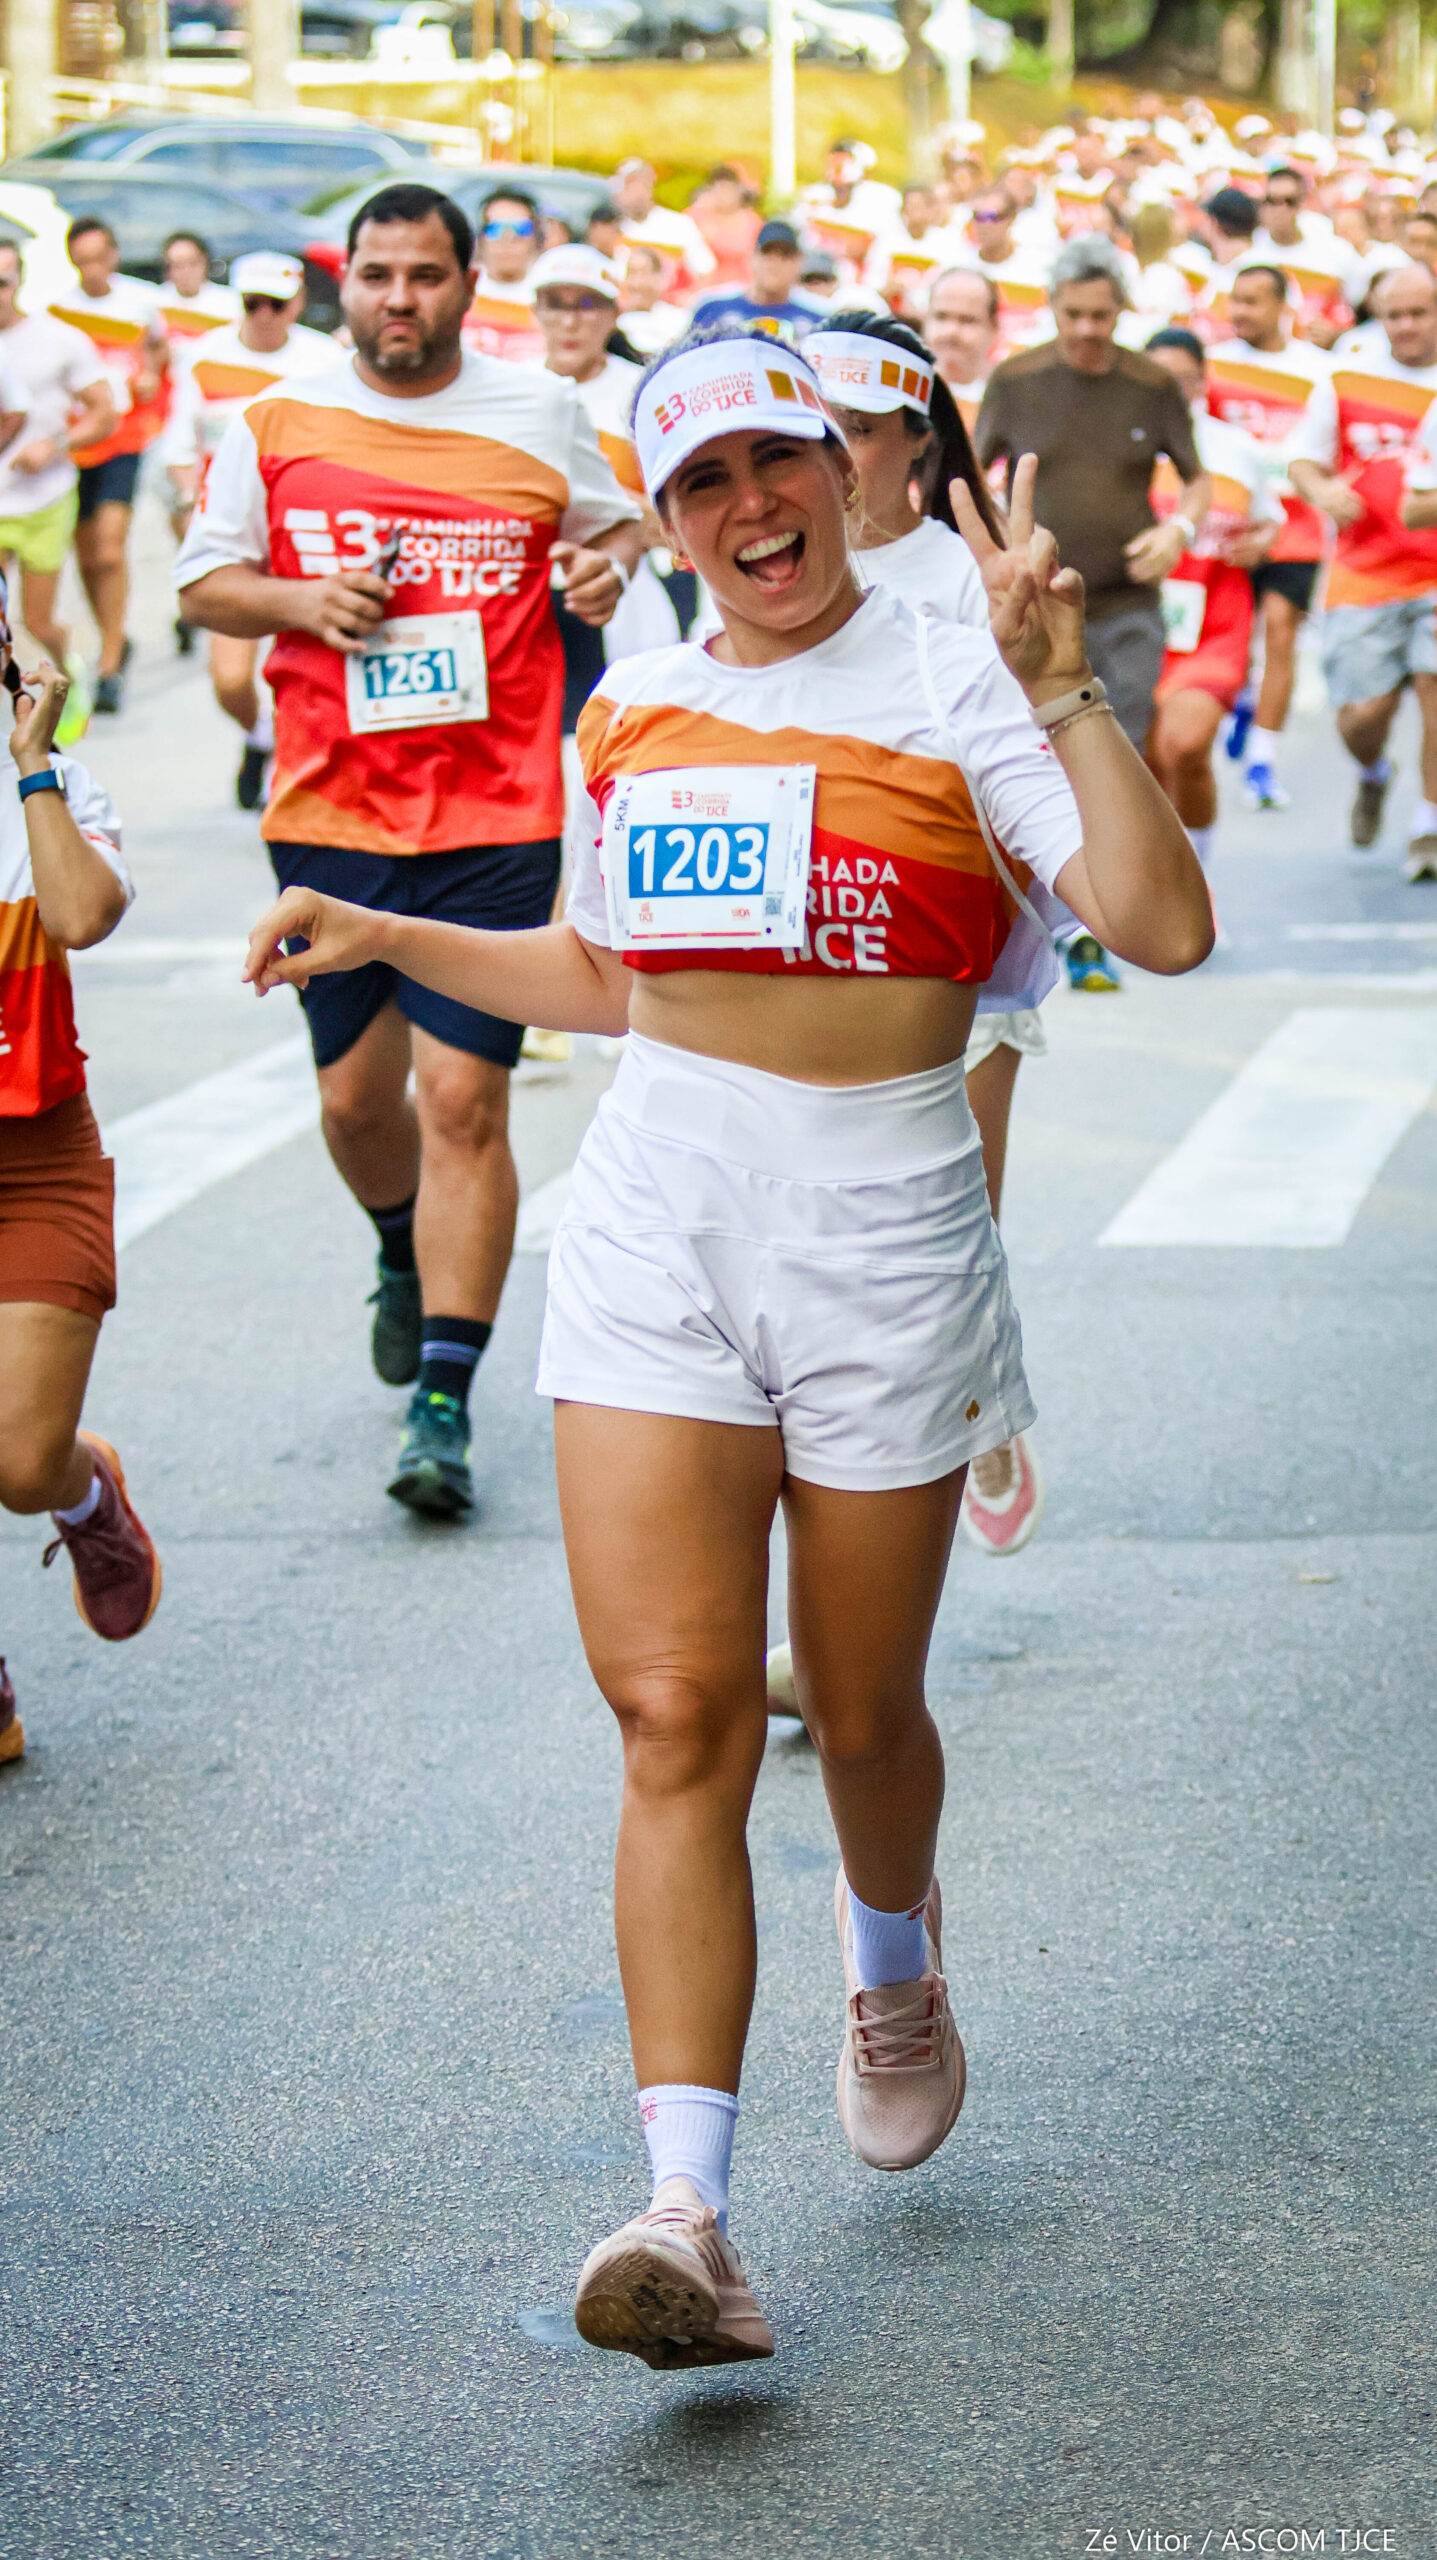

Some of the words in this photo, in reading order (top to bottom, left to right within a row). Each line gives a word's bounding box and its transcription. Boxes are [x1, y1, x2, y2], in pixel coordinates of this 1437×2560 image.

[713, 388, 757, 411] TJCE
[394, 518, 533, 537] CAMINHADA
[388, 558, 432, 585] DO
[434, 559, 526, 597] TJCE
[367, 651, 454, 696] 1261
[614, 798, 630, 831] 5KM
[706, 805, 728, 817] TJCE
[632, 826, 765, 891] 1203
